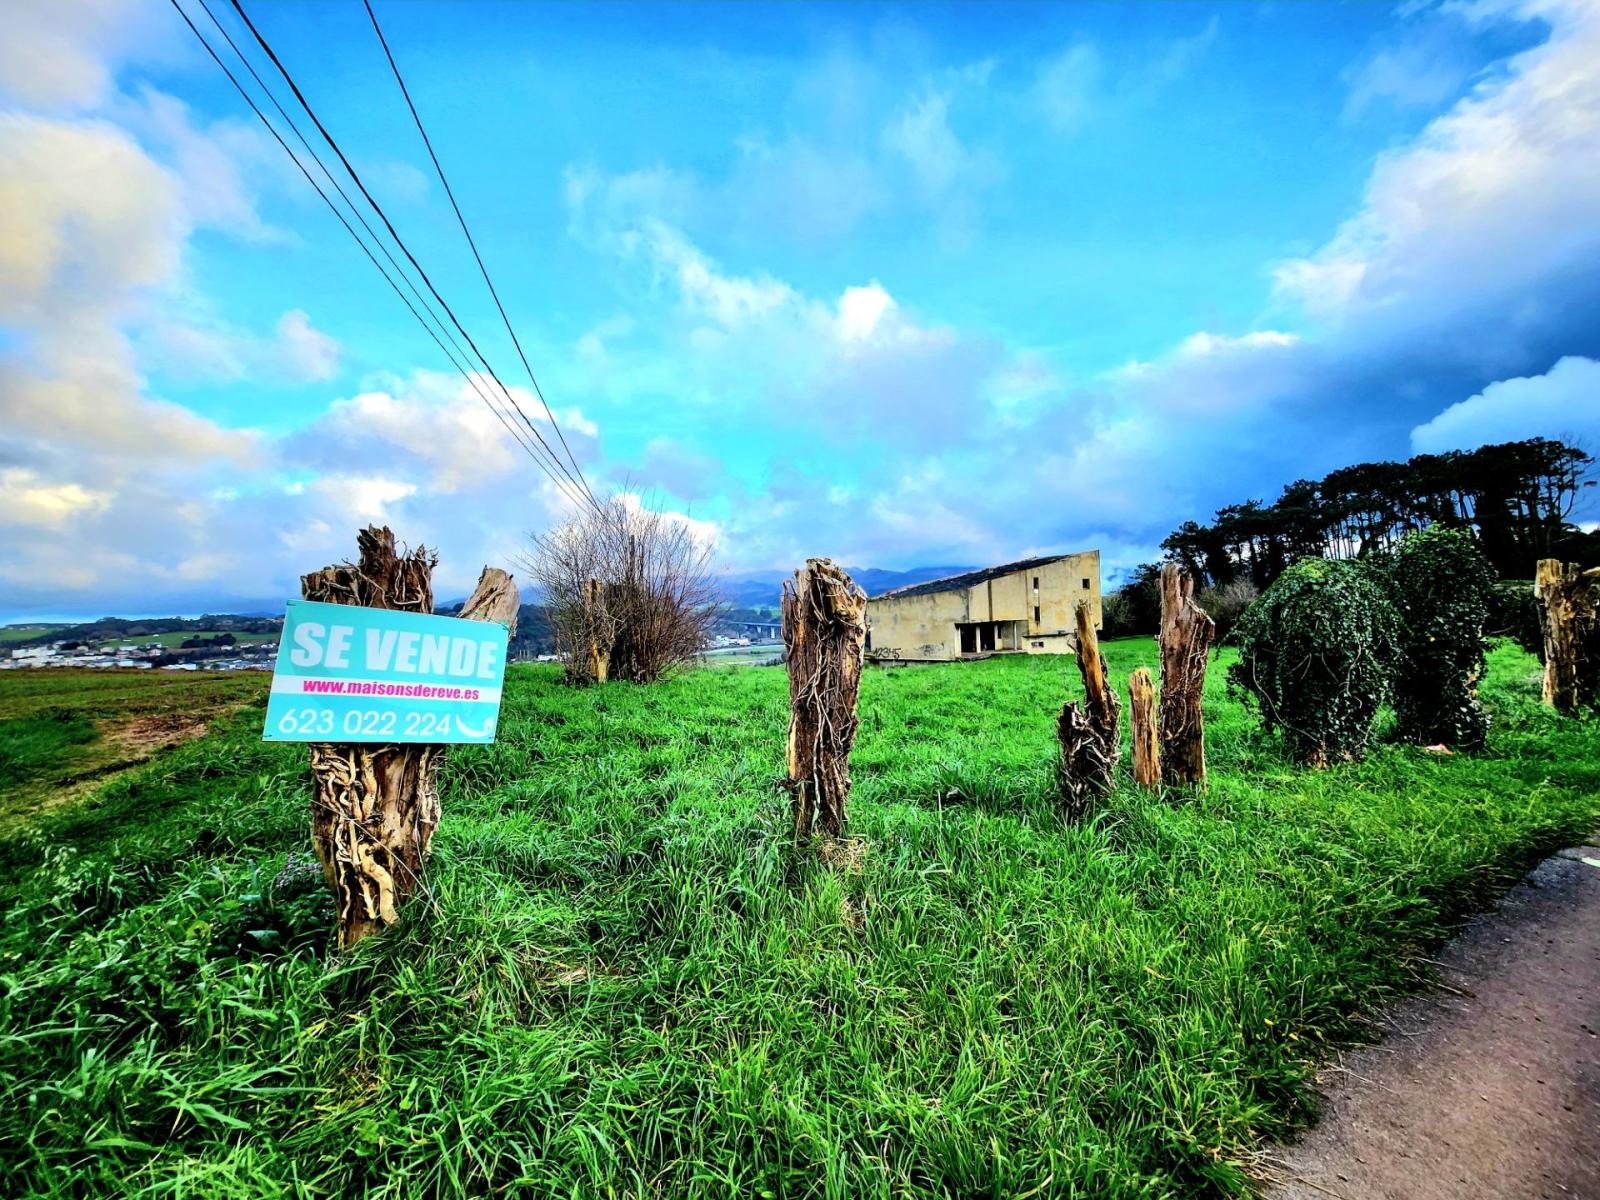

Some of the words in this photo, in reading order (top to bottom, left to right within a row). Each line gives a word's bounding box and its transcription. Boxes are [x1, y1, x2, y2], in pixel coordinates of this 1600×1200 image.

[291, 622, 353, 668] SE
[366, 628, 498, 678] VENDE
[303, 680, 479, 700] www.maisonsdereve.es
[278, 709, 334, 734] 623
[343, 711, 396, 735] 022
[404, 712, 451, 736] 224
